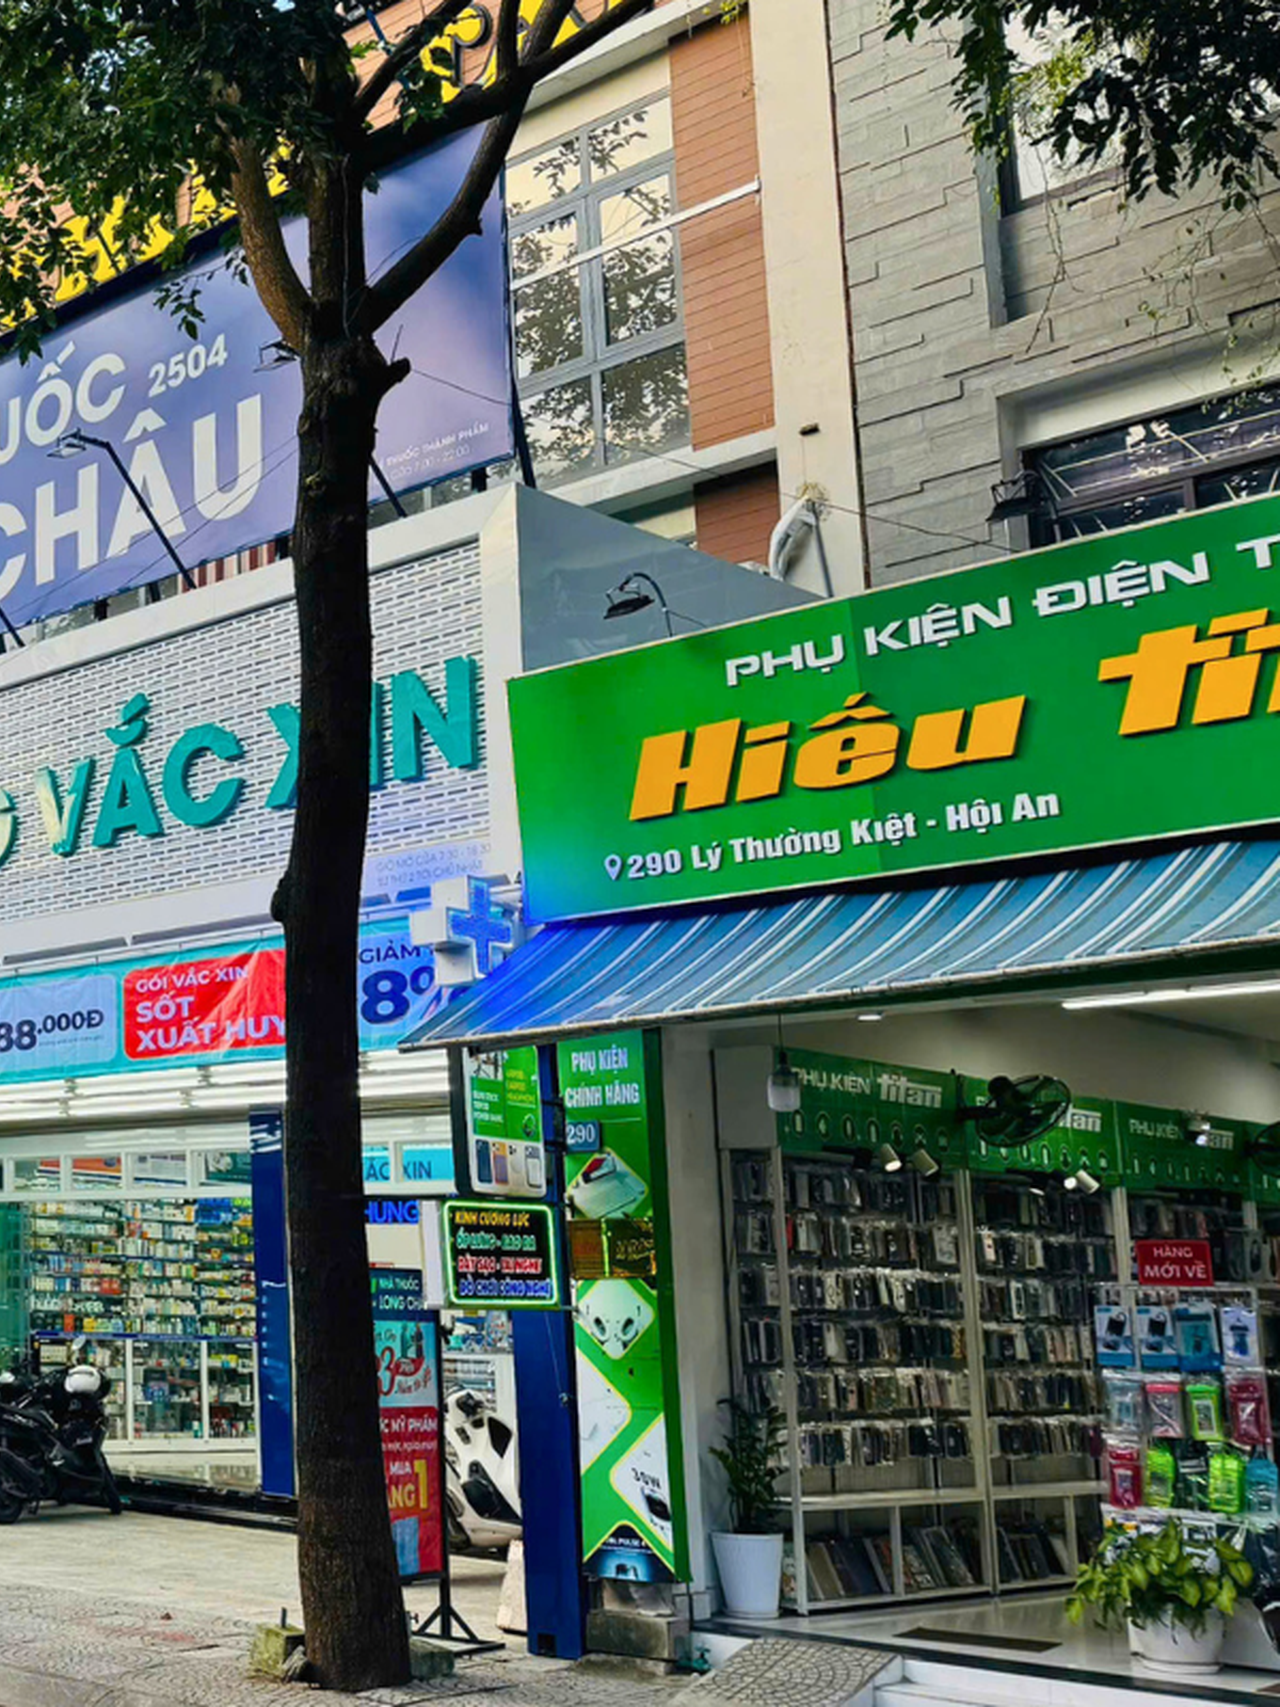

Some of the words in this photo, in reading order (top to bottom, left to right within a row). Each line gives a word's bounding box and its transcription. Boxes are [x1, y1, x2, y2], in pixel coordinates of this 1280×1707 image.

[147, 333, 227, 398] 2504
[725, 633, 846, 688] PHỤ
[864, 597, 1011, 656] KIỆN
[1032, 551, 1211, 617] ĐIỆN
[628, 692, 1026, 821] Hiếu
[34, 692, 246, 856] VẮC
[627, 851, 682, 879] 290
[691, 843, 722, 871] Lý
[730, 827, 841, 863] Thường
[851, 812, 917, 847] Kiệt
[945, 799, 1002, 833] Hội
[1012, 793, 1060, 821] An
[358, 940, 421, 965] GIẢM
[135, 975, 168, 994] GÓI
[215, 965, 249, 983] XIN
[135, 989, 195, 1024] SỐT
[135, 1015, 217, 1052] XUẤT
[225, 1016, 286, 1040] HUY
[571, 1051, 596, 1075] PHỤ
[598, 1044, 628, 1074] KIỆN
[565, 1081, 603, 1108] CHÍNH
[566, 1124, 596, 1145] 290
[1153, 1245, 1193, 1258] HÀNG
[1144, 1263, 1182, 1279] MỚI
[1184, 1260, 1207, 1279] VỀ
